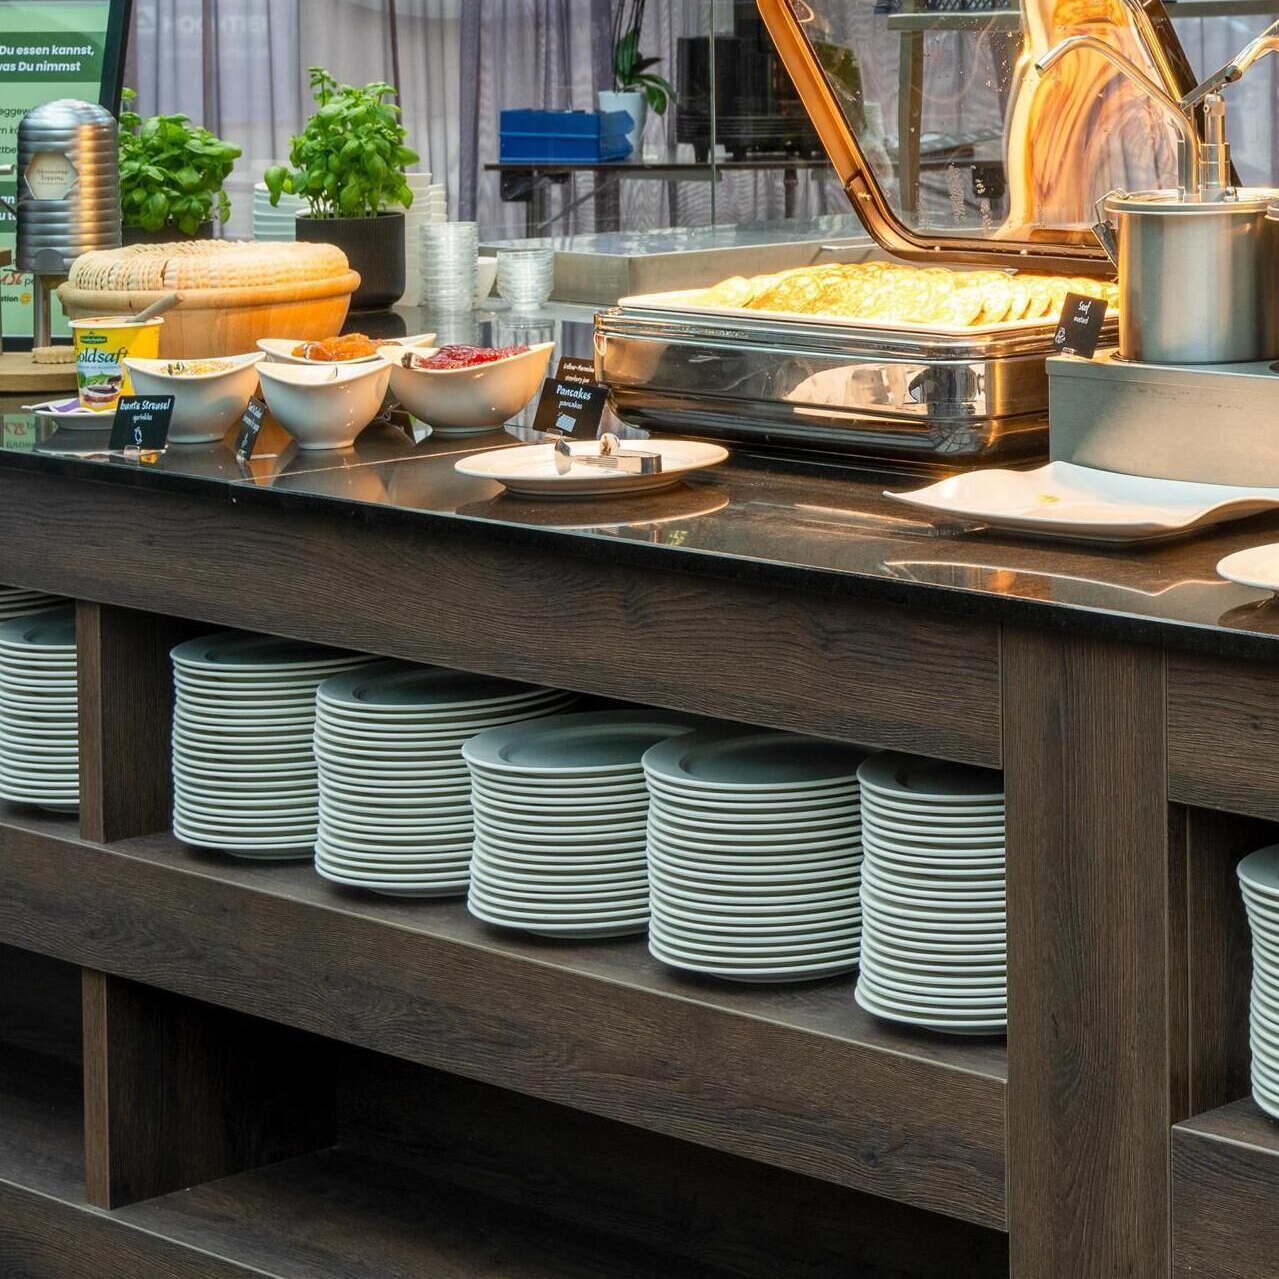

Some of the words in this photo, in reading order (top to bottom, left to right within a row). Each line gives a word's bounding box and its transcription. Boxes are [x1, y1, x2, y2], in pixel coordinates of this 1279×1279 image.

[16, 46, 50, 56] essen
[51, 45, 95, 57] kannst,
[18, 62, 34, 72] Du
[36, 61, 81, 72] nimmst
[556, 384, 593, 400] Pancakes
[558, 400, 583, 410] pancakes
